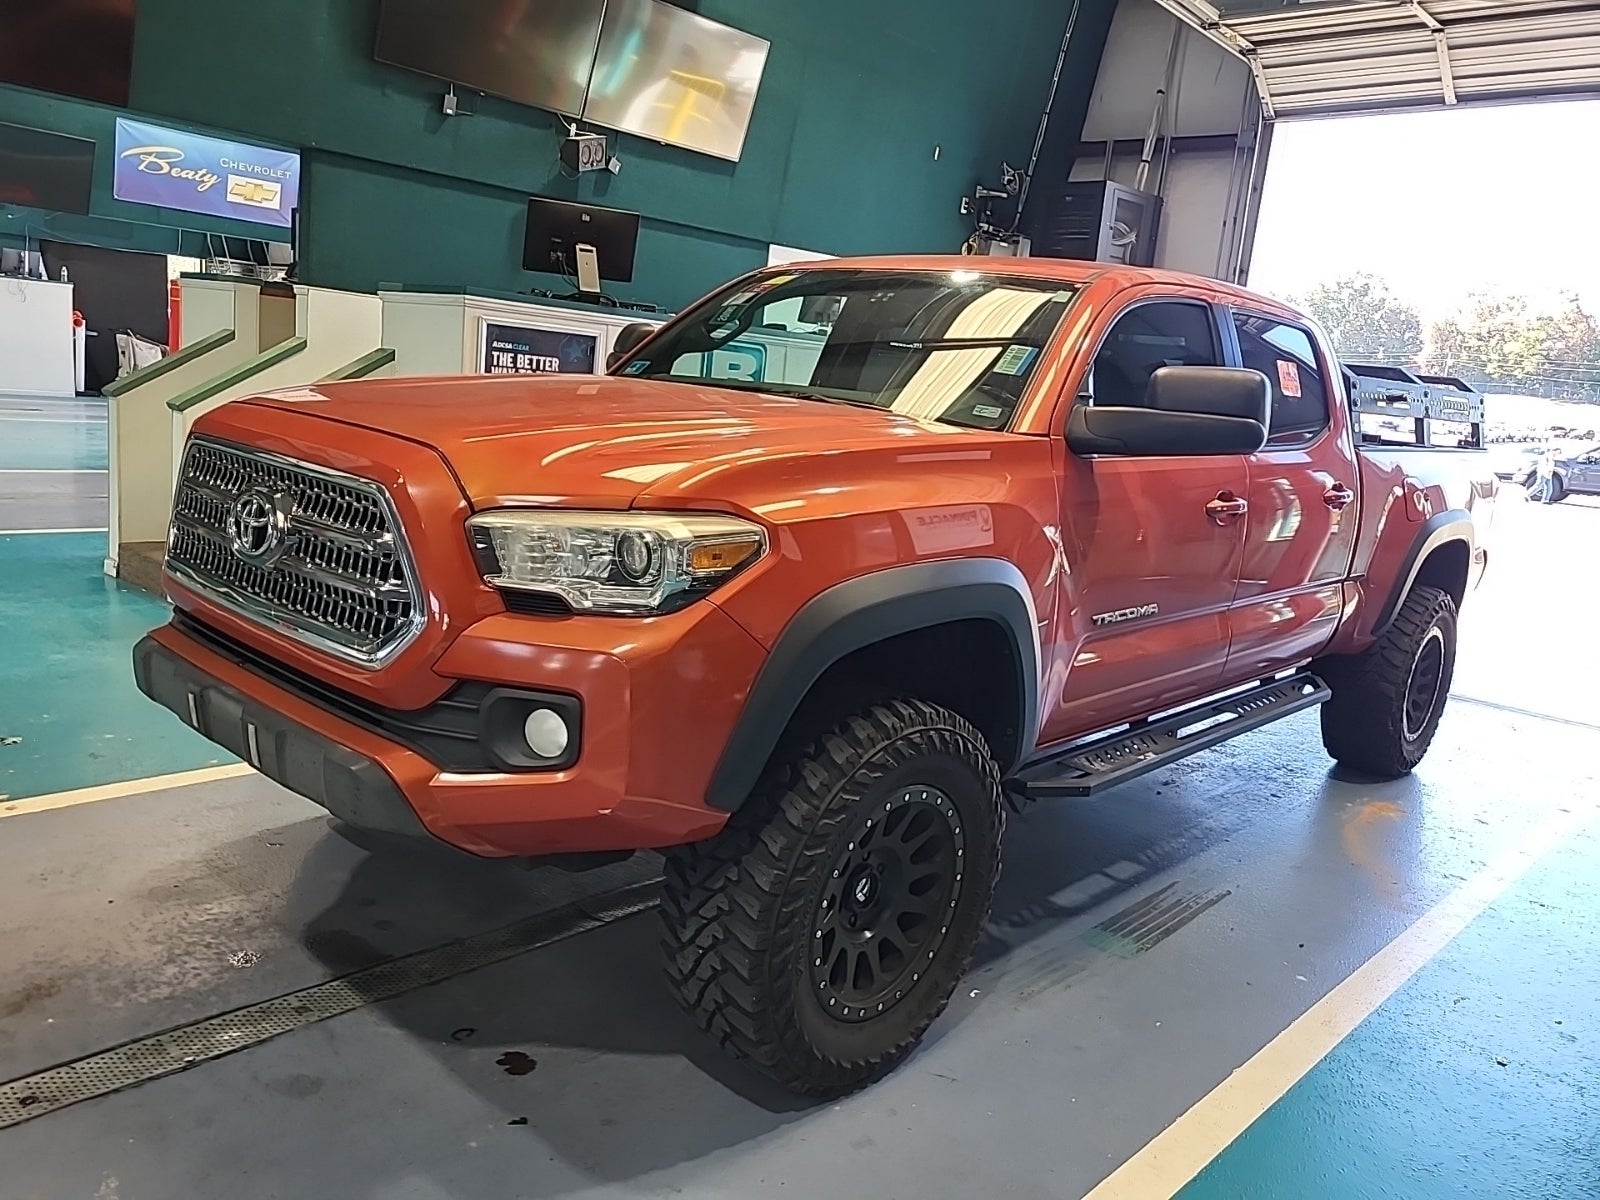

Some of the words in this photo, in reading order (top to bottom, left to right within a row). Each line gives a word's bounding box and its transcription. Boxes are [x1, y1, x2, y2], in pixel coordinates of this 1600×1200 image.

[120, 146, 222, 192] Beaty
[219, 157, 292, 180] CHEVROLET
[513, 343, 530, 352] CLEAR
[491, 351, 515, 367] THE
[516, 354, 560, 372] BETTER
[1092, 603, 1159, 626] TACOMA
